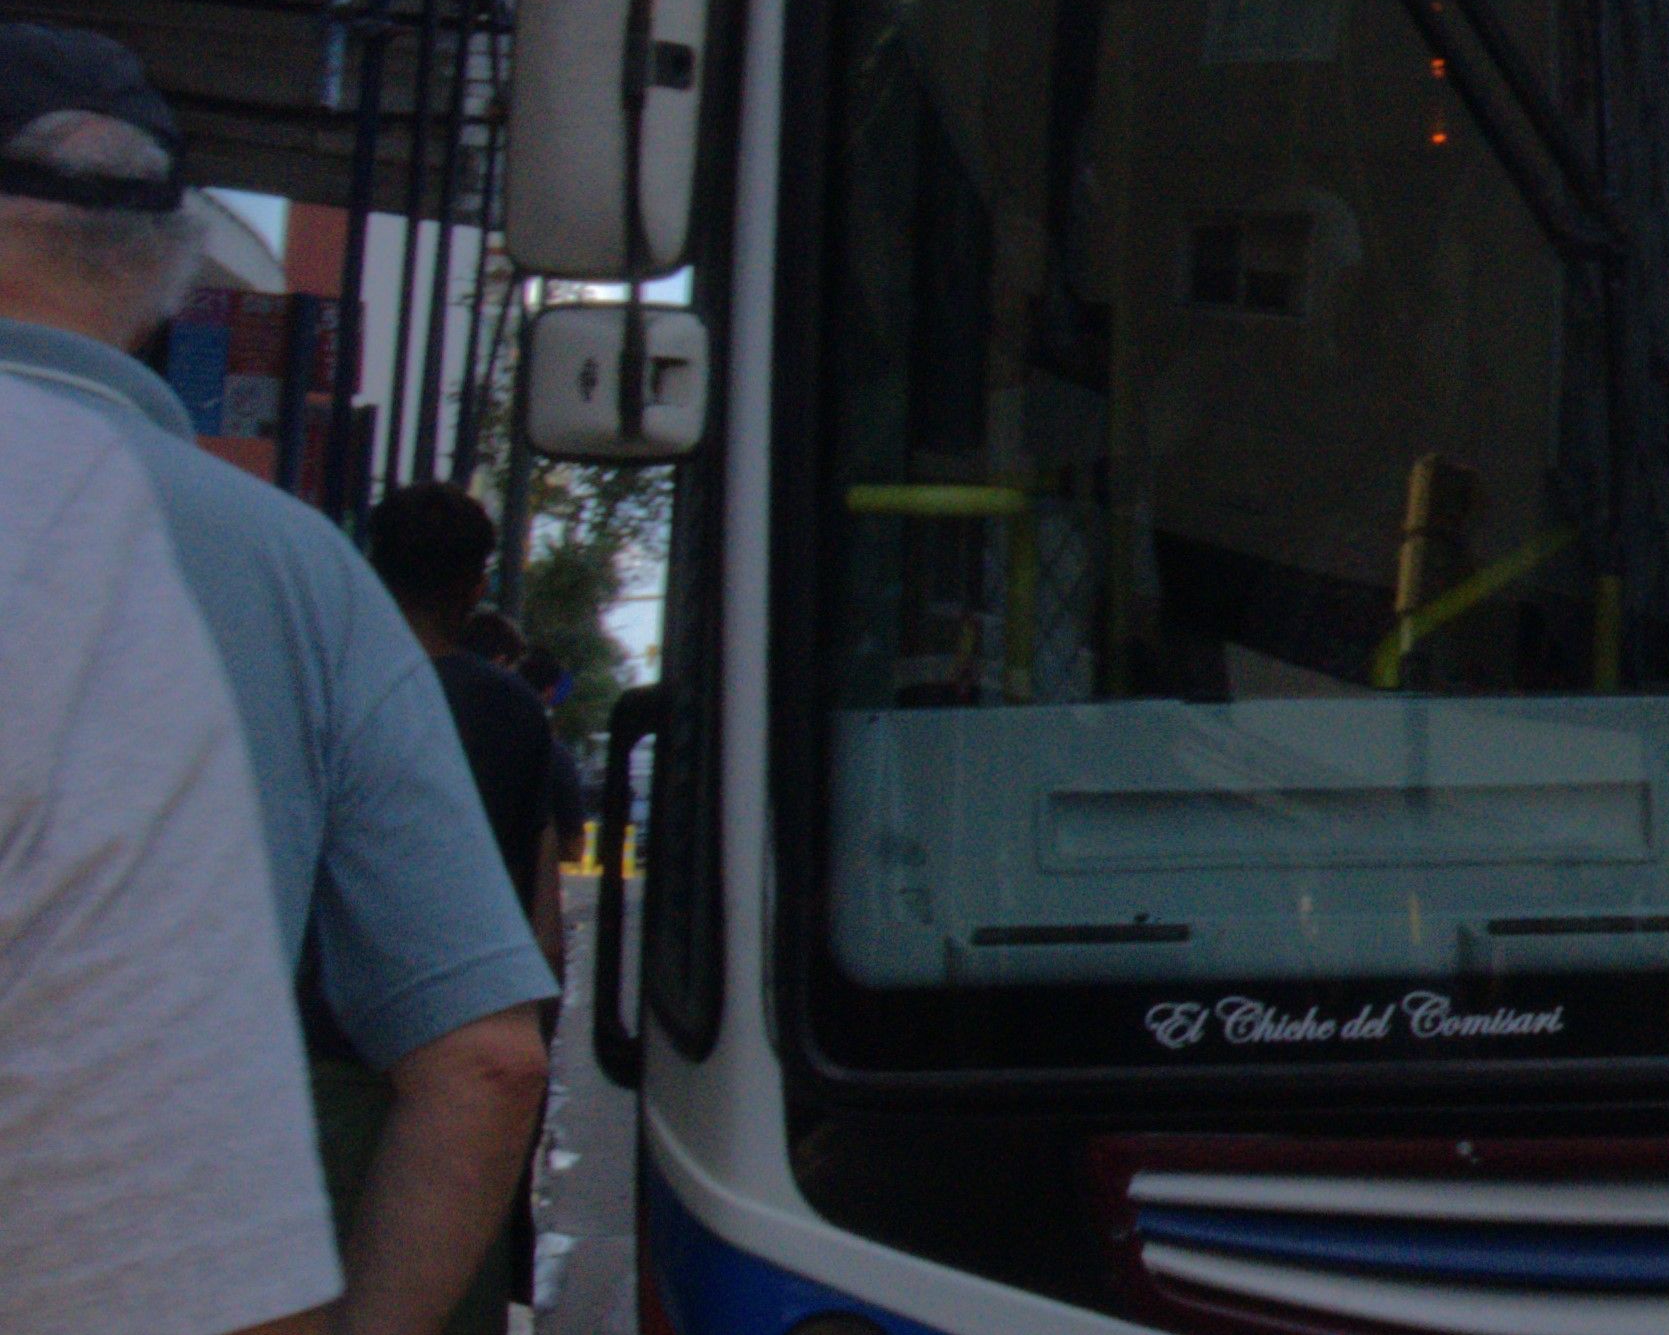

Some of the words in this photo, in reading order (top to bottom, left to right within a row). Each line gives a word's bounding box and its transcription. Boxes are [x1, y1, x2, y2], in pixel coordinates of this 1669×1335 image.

[1144, 1001, 1208, 1049] El
[1214, 995, 1337, 1044] Chiche
[1339, 1003, 1397, 1040] del
